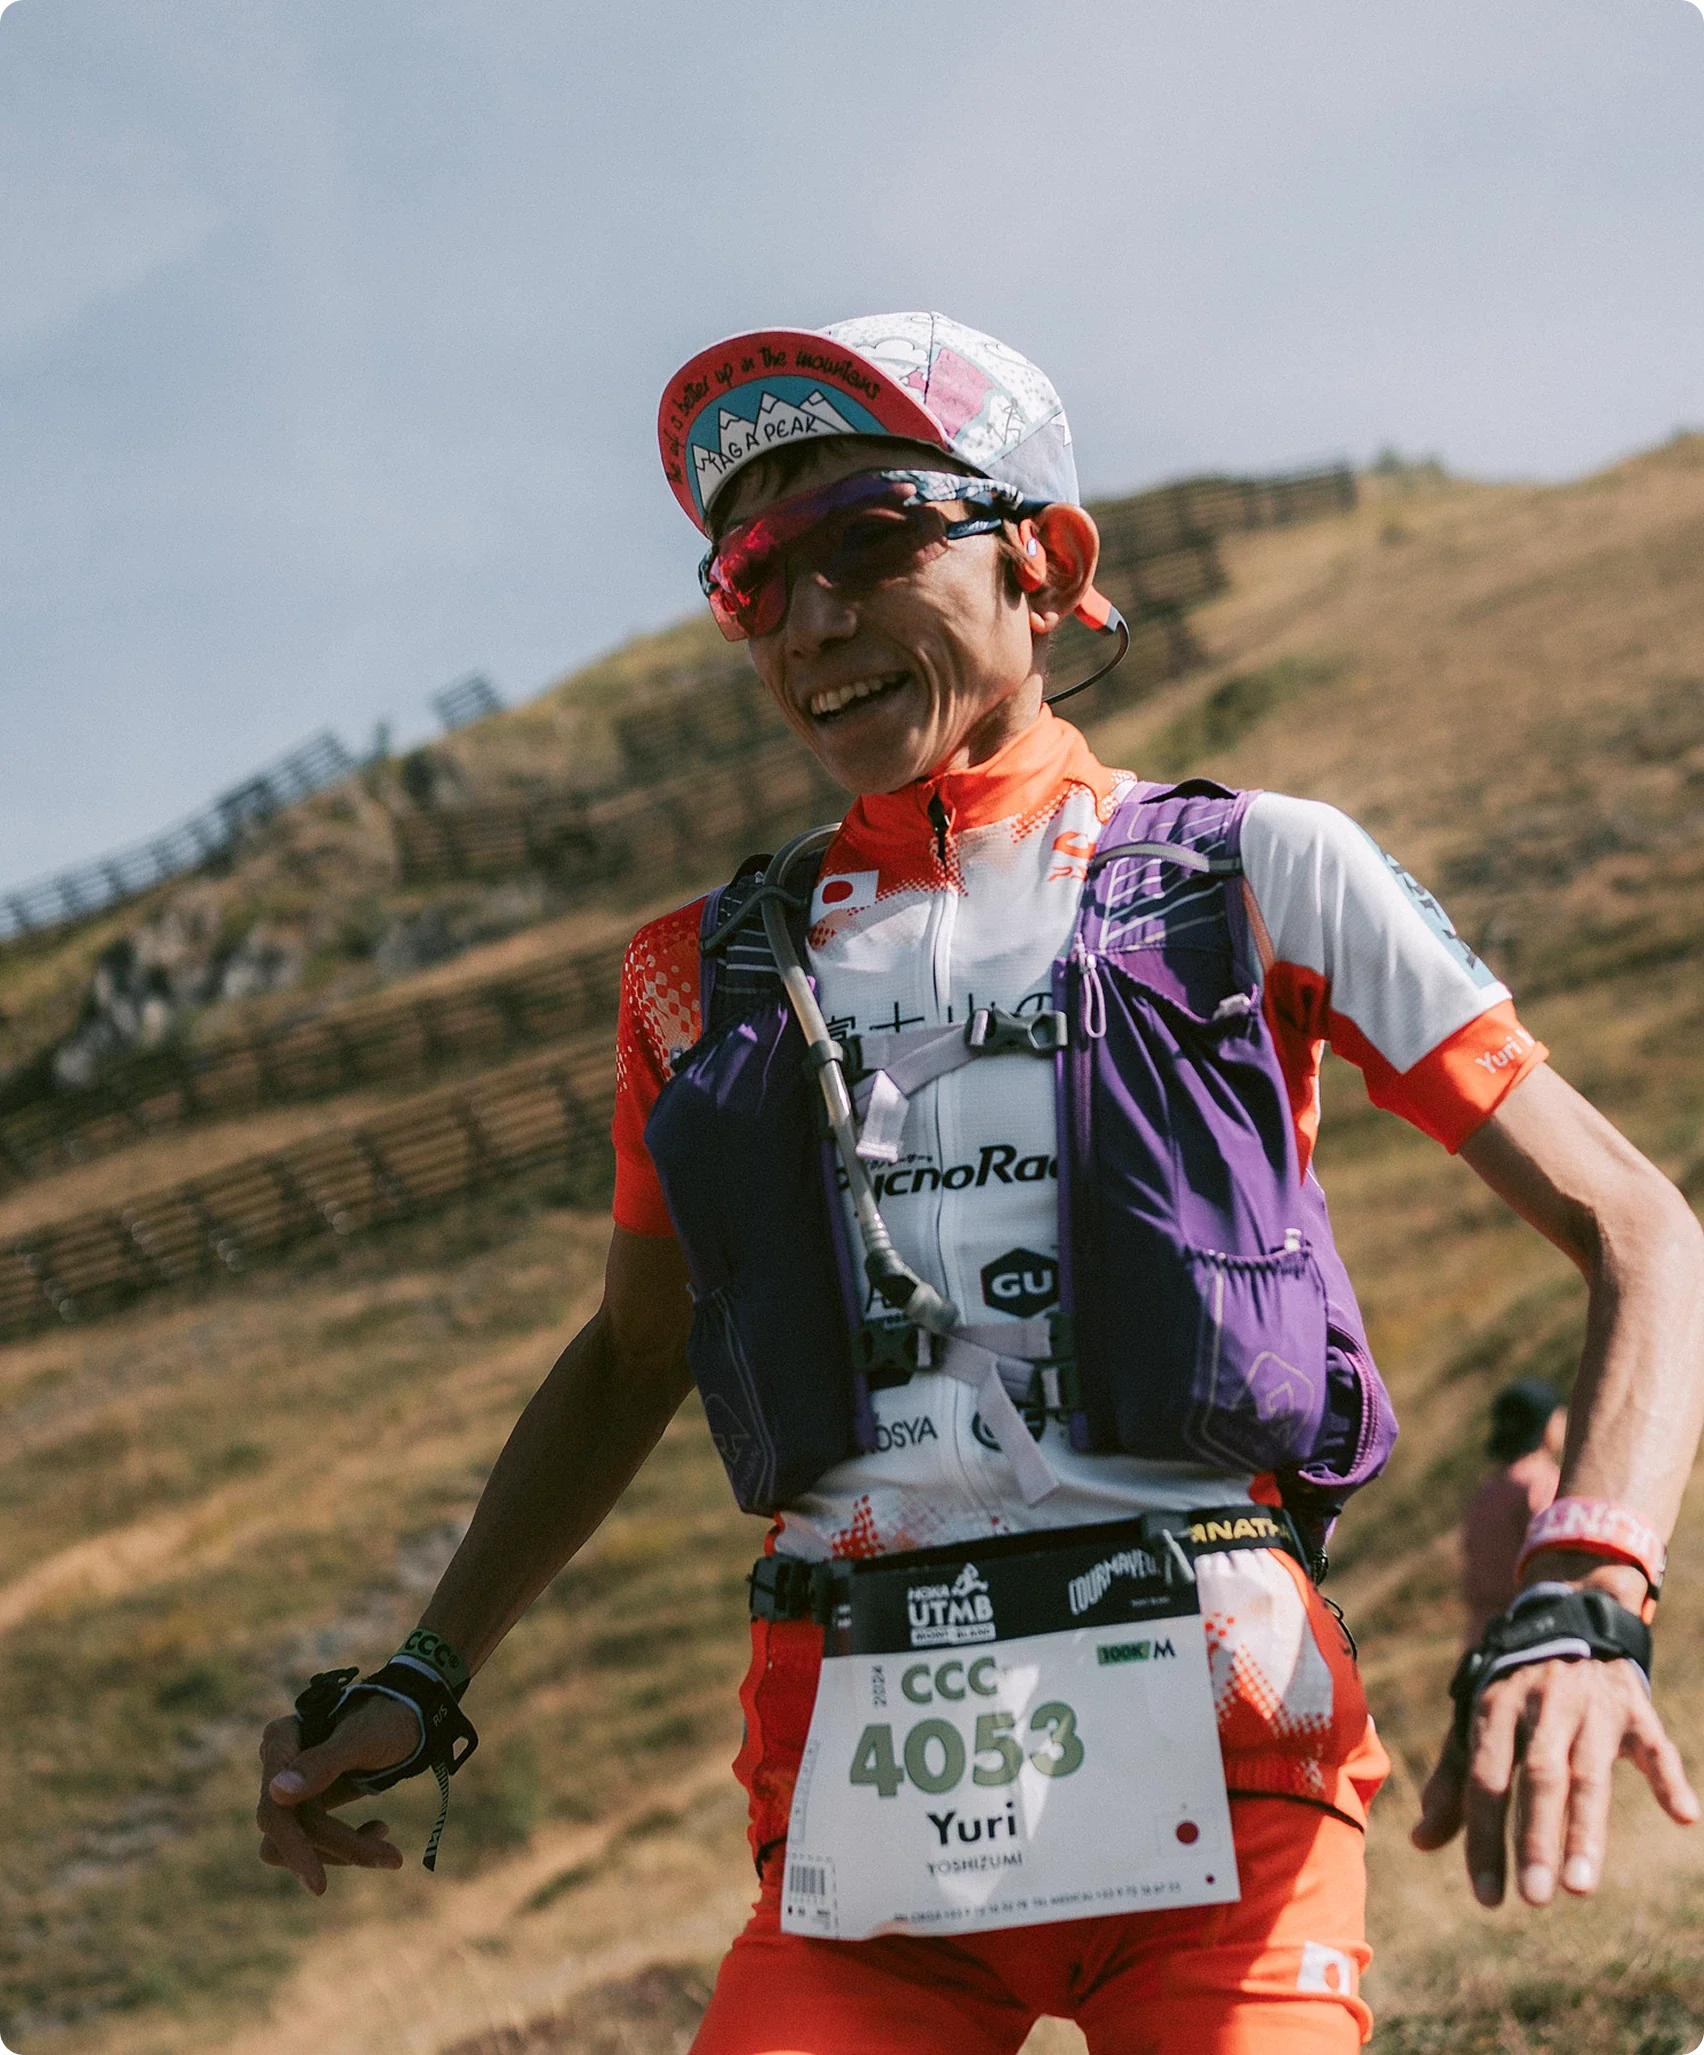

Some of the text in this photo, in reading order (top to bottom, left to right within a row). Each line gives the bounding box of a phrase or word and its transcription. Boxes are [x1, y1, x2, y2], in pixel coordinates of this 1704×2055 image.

[715, 362, 733, 389] up
[759, 345, 786, 368] the
[763, 416, 818, 442] PEAK
[1475, 1035, 1522, 1074] Yuri
[991, 1270, 1053, 1298] GU
[874, 1414, 939, 1451] OSYA
[908, 1594, 994, 1628] UTMB
[405, 1633, 454, 1667] CCC
[901, 1656, 999, 1705] CCC
[849, 1701, 1084, 1798] 4053
[926, 1801, 1018, 1846] Yuri
[927, 1852, 1024, 1876] YOSHIZUMI
